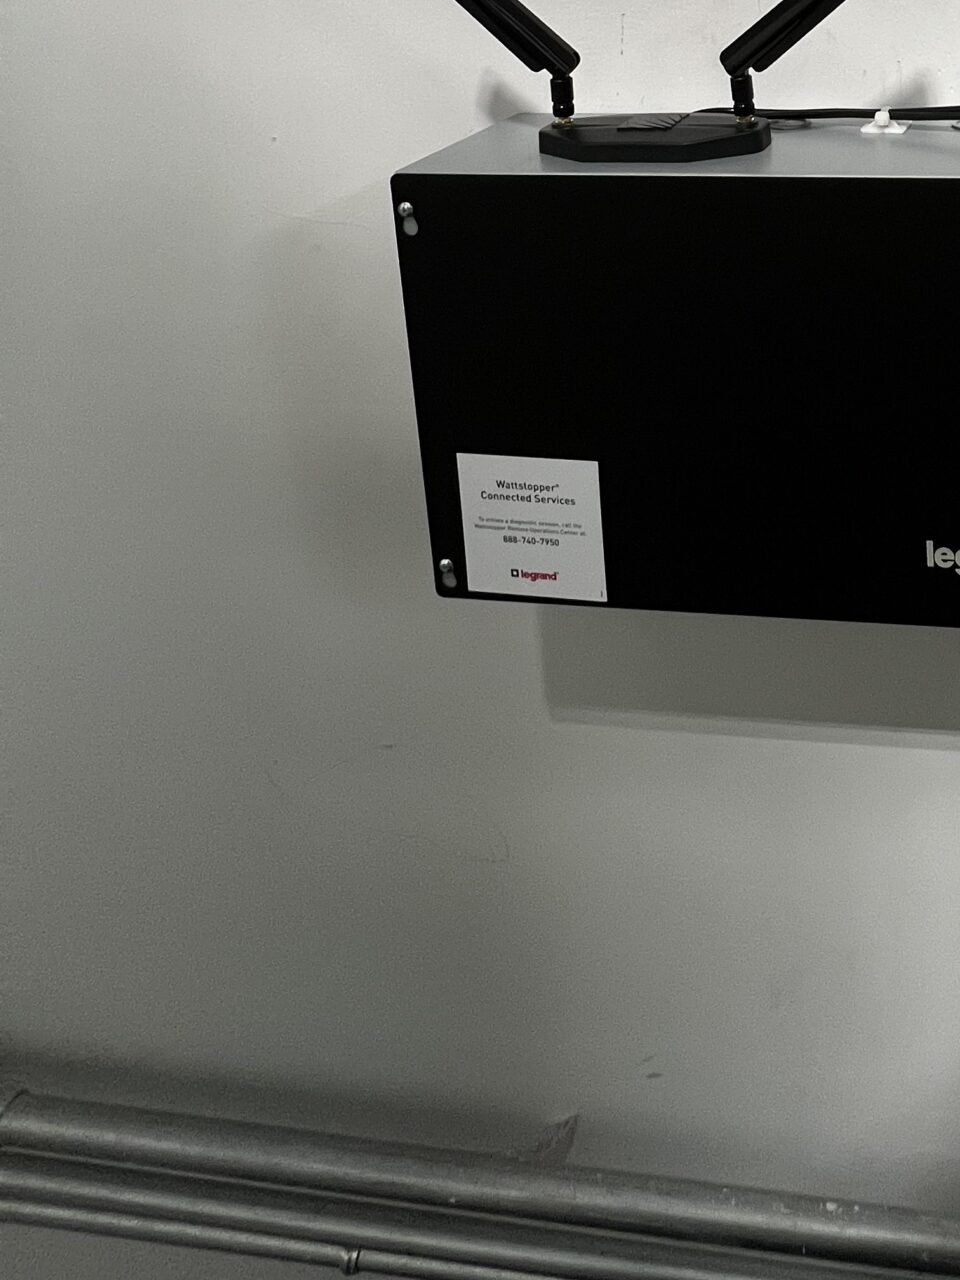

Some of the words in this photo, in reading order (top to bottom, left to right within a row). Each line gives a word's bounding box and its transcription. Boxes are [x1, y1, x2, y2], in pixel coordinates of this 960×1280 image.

[480, 490, 532, 503] Connected
[534, 494, 576, 505] Services
[503, 535, 559, 546] 888-740-7950
